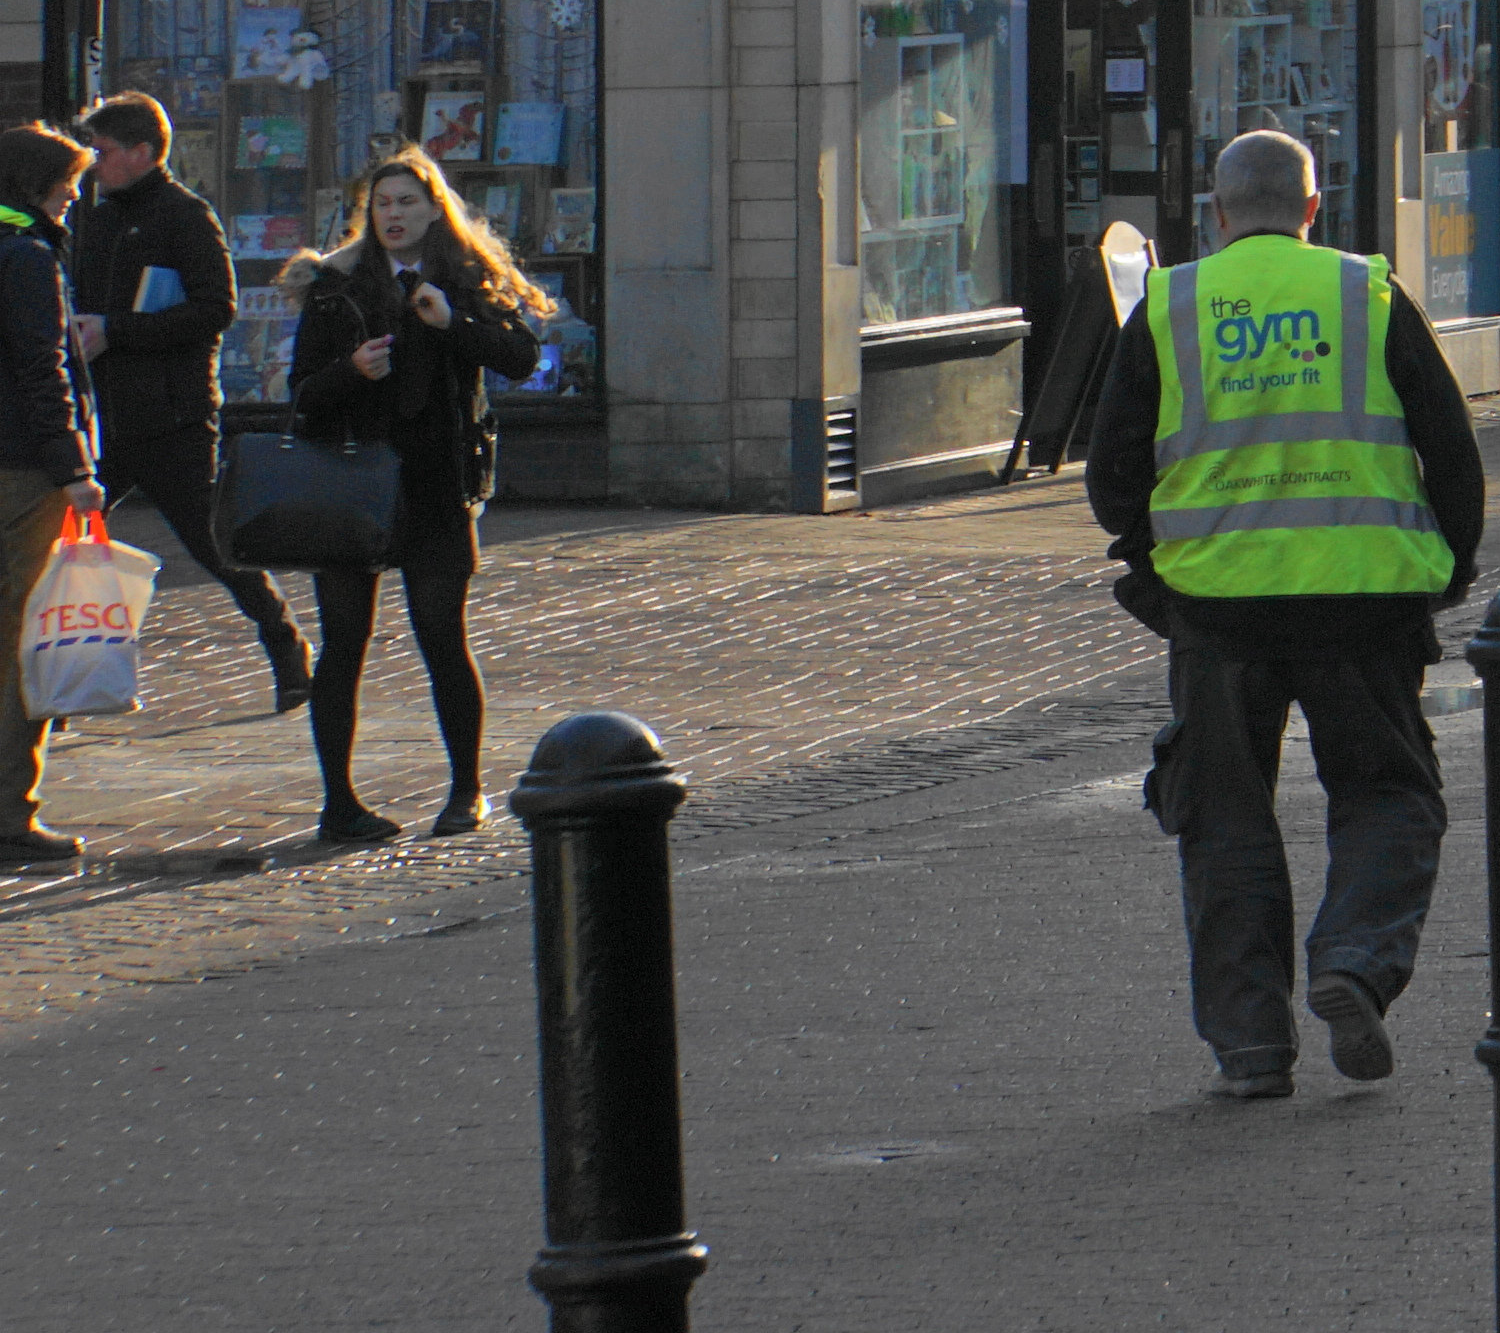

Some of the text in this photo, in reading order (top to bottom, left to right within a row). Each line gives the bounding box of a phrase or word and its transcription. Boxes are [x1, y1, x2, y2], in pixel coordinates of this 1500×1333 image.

[1429, 203, 1476, 258] Value
[1211, 295, 1252, 319] the
[1215, 309, 1321, 363] gym
[1220, 367, 1321, 394] find your fit
[1215, 469, 1352, 492] OAKWHITE CONTRACTS
